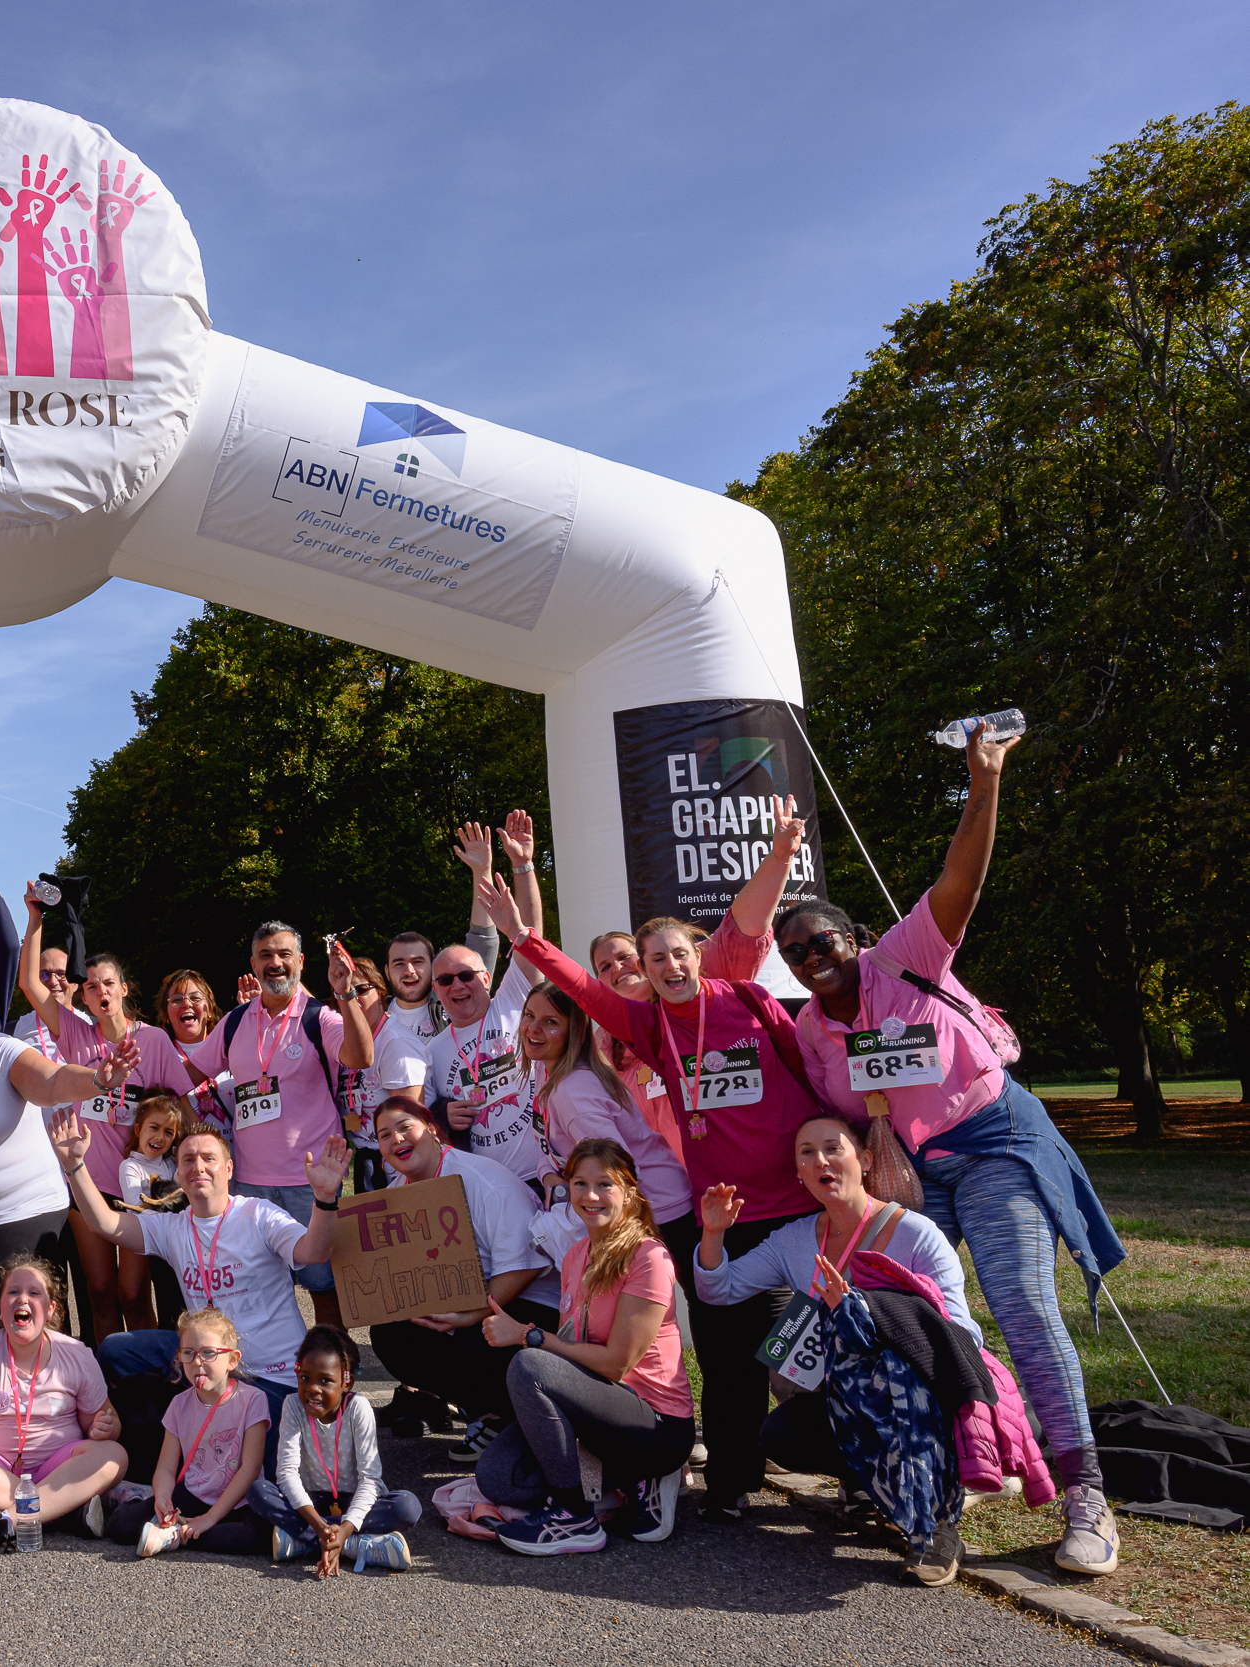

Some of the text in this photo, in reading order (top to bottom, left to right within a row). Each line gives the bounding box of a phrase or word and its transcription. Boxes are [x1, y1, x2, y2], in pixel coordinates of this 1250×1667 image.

[8, 389, 133, 427] ROSE
[284, 459, 507, 543] ABN Fermetures
[295, 509, 470, 572] Menuiserie Extérieure
[293, 530, 459, 590] Serrurerie-Métallerie
[667, 753, 722, 793] EL.
[672, 796, 806, 838] GRAPH
[675, 841, 815, 883] DESIGER
[678, 892, 717, 904] Identité
[720, 893, 732, 902] de
[780, 891, 800, 901] otion
[690, 907, 729, 917] Commu
[858, 1040, 874, 1048] TDR
[889, 1036, 926, 1047] RUNNING
[866, 1053, 924, 1079] 685
[481, 1076, 508, 1097] 69
[699, 1075, 749, 1099] 728
[242, 1099, 271, 1119] 819
[508, 1121, 523, 1136] SE
[778, 1318, 794, 1339] TERRE
[790, 1304, 812, 1335] RUNNING
[770, 1340, 785, 1357] TDR
